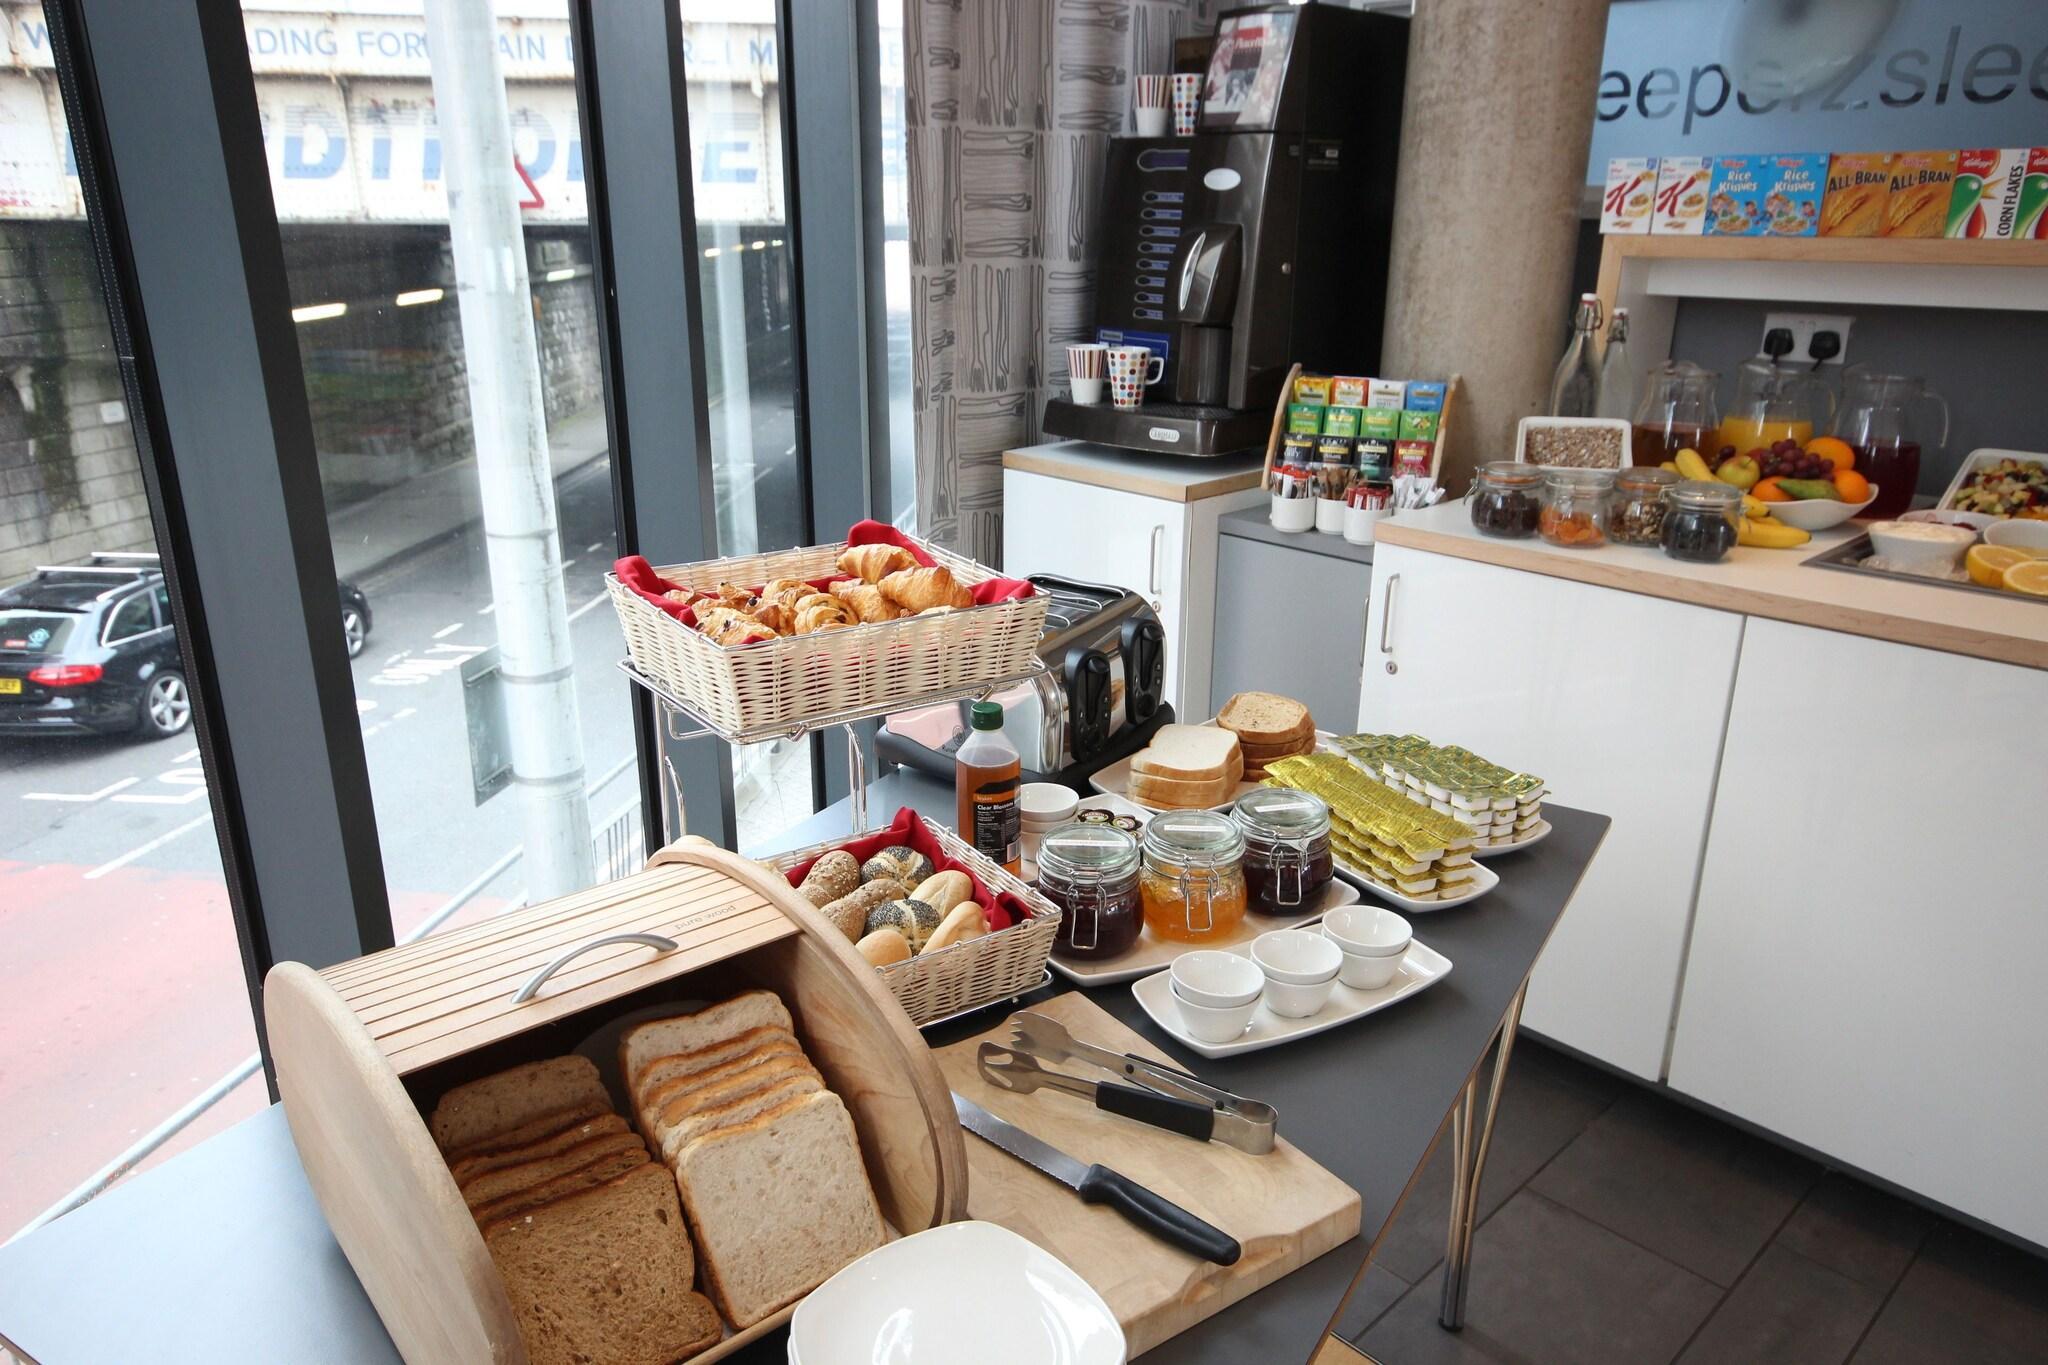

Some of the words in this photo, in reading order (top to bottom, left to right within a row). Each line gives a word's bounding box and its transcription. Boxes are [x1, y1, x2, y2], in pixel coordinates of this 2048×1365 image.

[247, 28, 338, 56] DING
[1728, 170, 1751, 181] Rice
[1784, 170, 1809, 180] Rice
[1720, 181, 1758, 193] Krispies
[1775, 181, 1816, 193] Krispies
[2004, 165, 2023, 205] FLAKES
[1998, 207, 2014, 236] CORN
